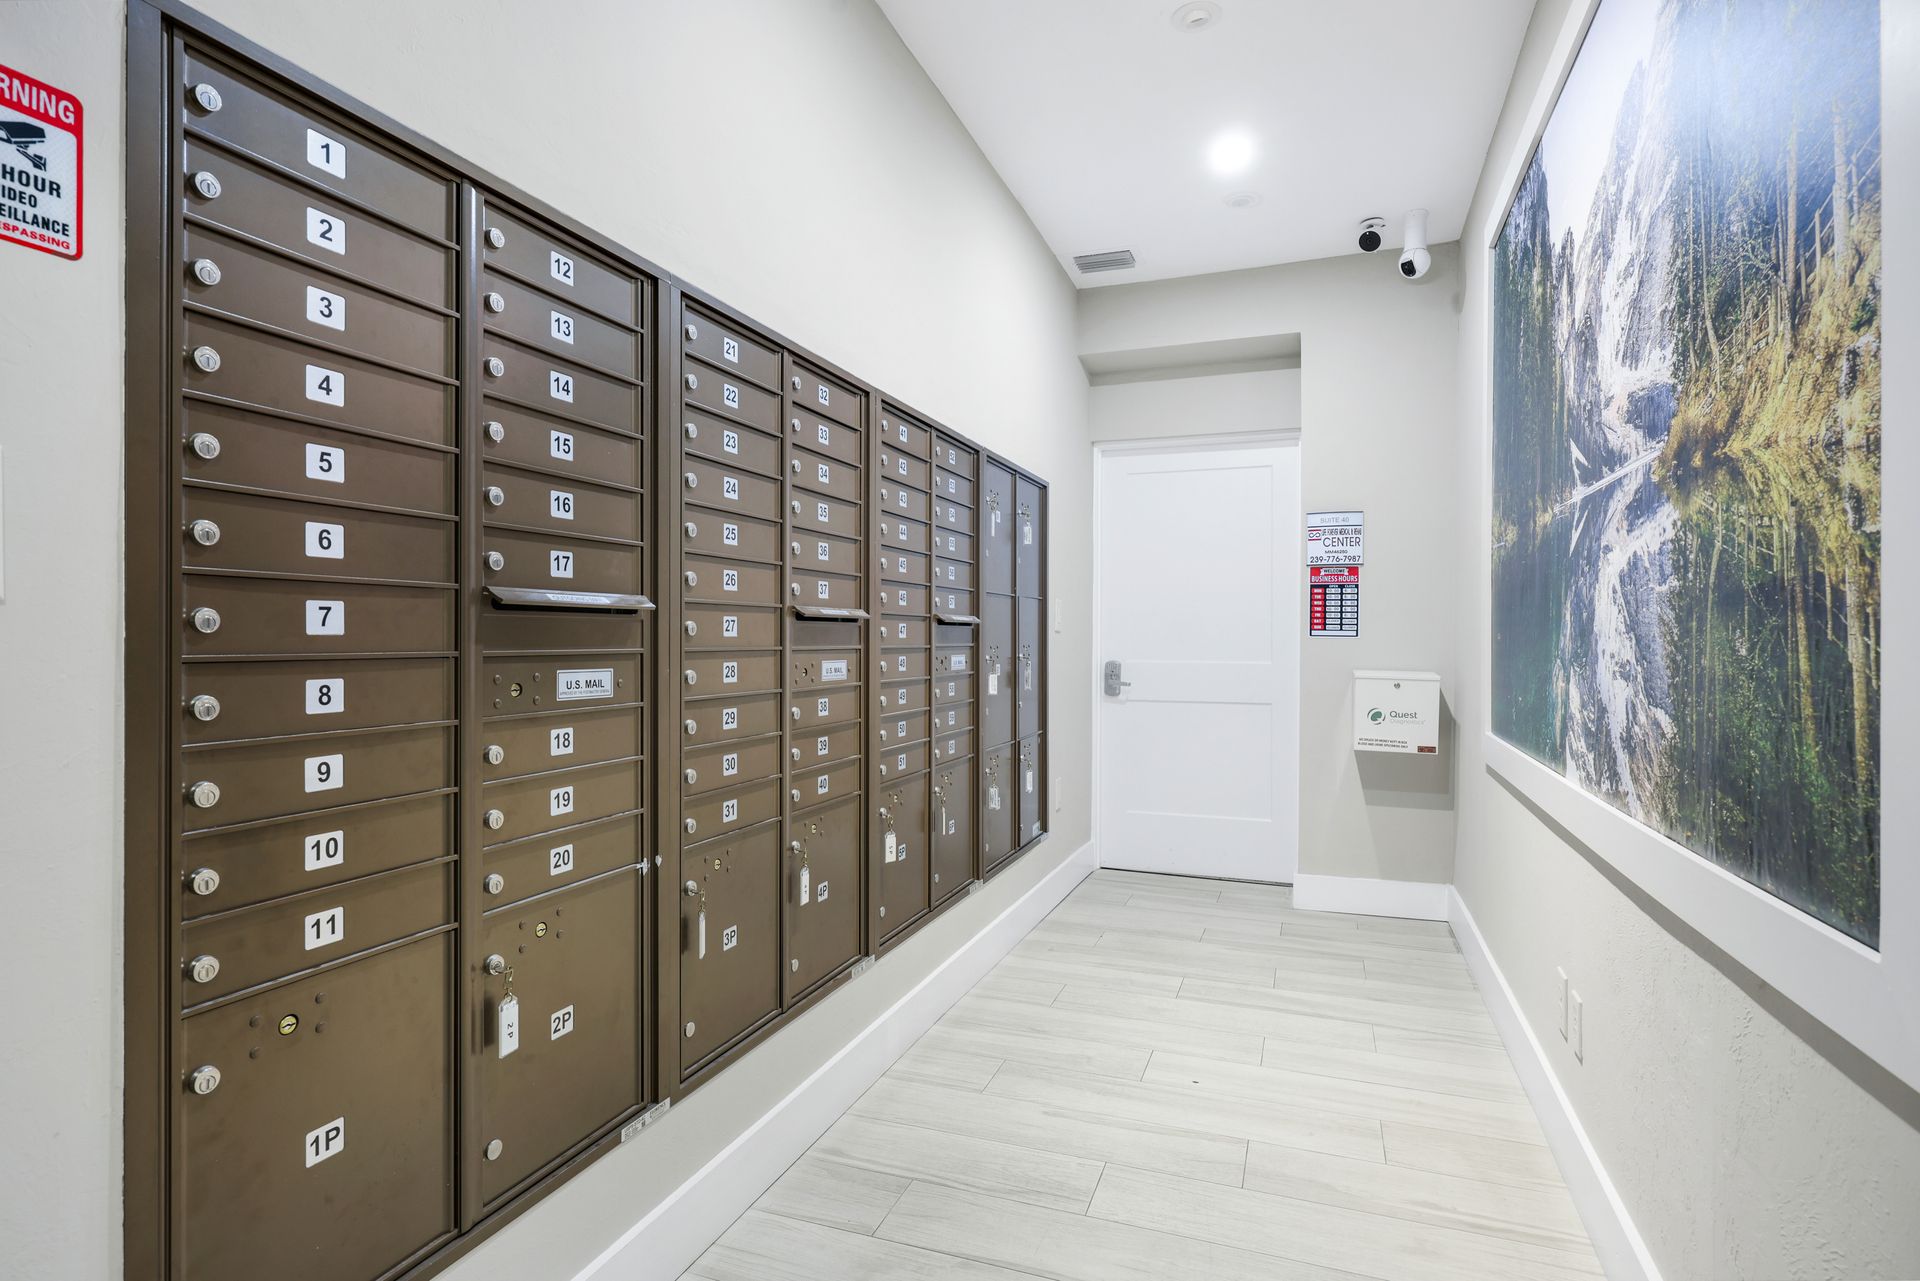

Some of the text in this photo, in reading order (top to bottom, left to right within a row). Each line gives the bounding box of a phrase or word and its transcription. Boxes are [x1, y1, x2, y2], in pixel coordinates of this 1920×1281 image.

[320, 142, 330, 164] 1
[2, 163, 61, 198] HOUR
[319, 218, 333, 242] 2
[554, 258, 571, 279] 12
[319, 296, 333, 318] 3
[554, 317, 571, 337] 13
[725, 341, 738, 359] 21
[317, 374, 333, 396] 4
[553, 376, 571, 396] 14
[725, 388, 738, 405] 22
[820, 388, 829, 403] 32
[819, 428, 829, 442] 33
[900, 427, 907, 440] 41
[554, 435, 571, 455] 15
[725, 434, 738, 450] 23
[318, 451, 333, 473] 5
[899, 460, 907, 473] 42
[819, 467, 829, 481] 34
[725, 481, 738, 496] 24
[554, 495, 571, 514] 16
[899, 493, 907, 506] 43
[819, 506, 828, 519] 35
[318, 528, 332, 551] 6
[725, 527, 738, 542] 25
[899, 526, 907, 538] 44
[1322, 536, 1361, 547] CENTER
[819, 545, 828, 557] 36
[553, 554, 571, 572] 17
[899, 559, 907, 571] 45
[1310, 555, 1361, 563] 239-776-7987
[725, 574, 737, 587] 26
[819, 584, 828, 596] 37
[899, 593, 906, 604] 46
[318, 606, 332, 627] 7
[724, 620, 737, 633] 27
[899, 626, 906, 636] 47
[899, 658, 906, 669] 48
[724, 666, 737, 679] 28
[566, 679, 604, 690] U.S. MAIL
[318, 684, 332, 706] 8
[899, 691, 906, 702] 49
[819, 701, 828, 713] 38
[1389, 710, 1418, 719] Quest
[724, 712, 737, 725] 29
[898, 723, 906, 735] 50
[554, 731, 571, 750] 18
[819, 740, 828, 752] 39
[724, 758, 737, 772] 30
[898, 756, 906, 768] 51
[317, 761, 331, 783] 9
[819, 778, 828, 791] 40
[554, 791, 571, 809] 19
[724, 804, 737, 818] 31
[311, 837, 339, 862] 10
[898, 847, 906, 859] 5P
[553, 849, 571, 870] 20
[819, 884, 828, 899] 4P
[310, 913, 336, 940] 11
[725, 929, 736, 946] 3P
[553, 1011, 572, 1035] 2P
[309, 1125, 341, 1157] 1P
